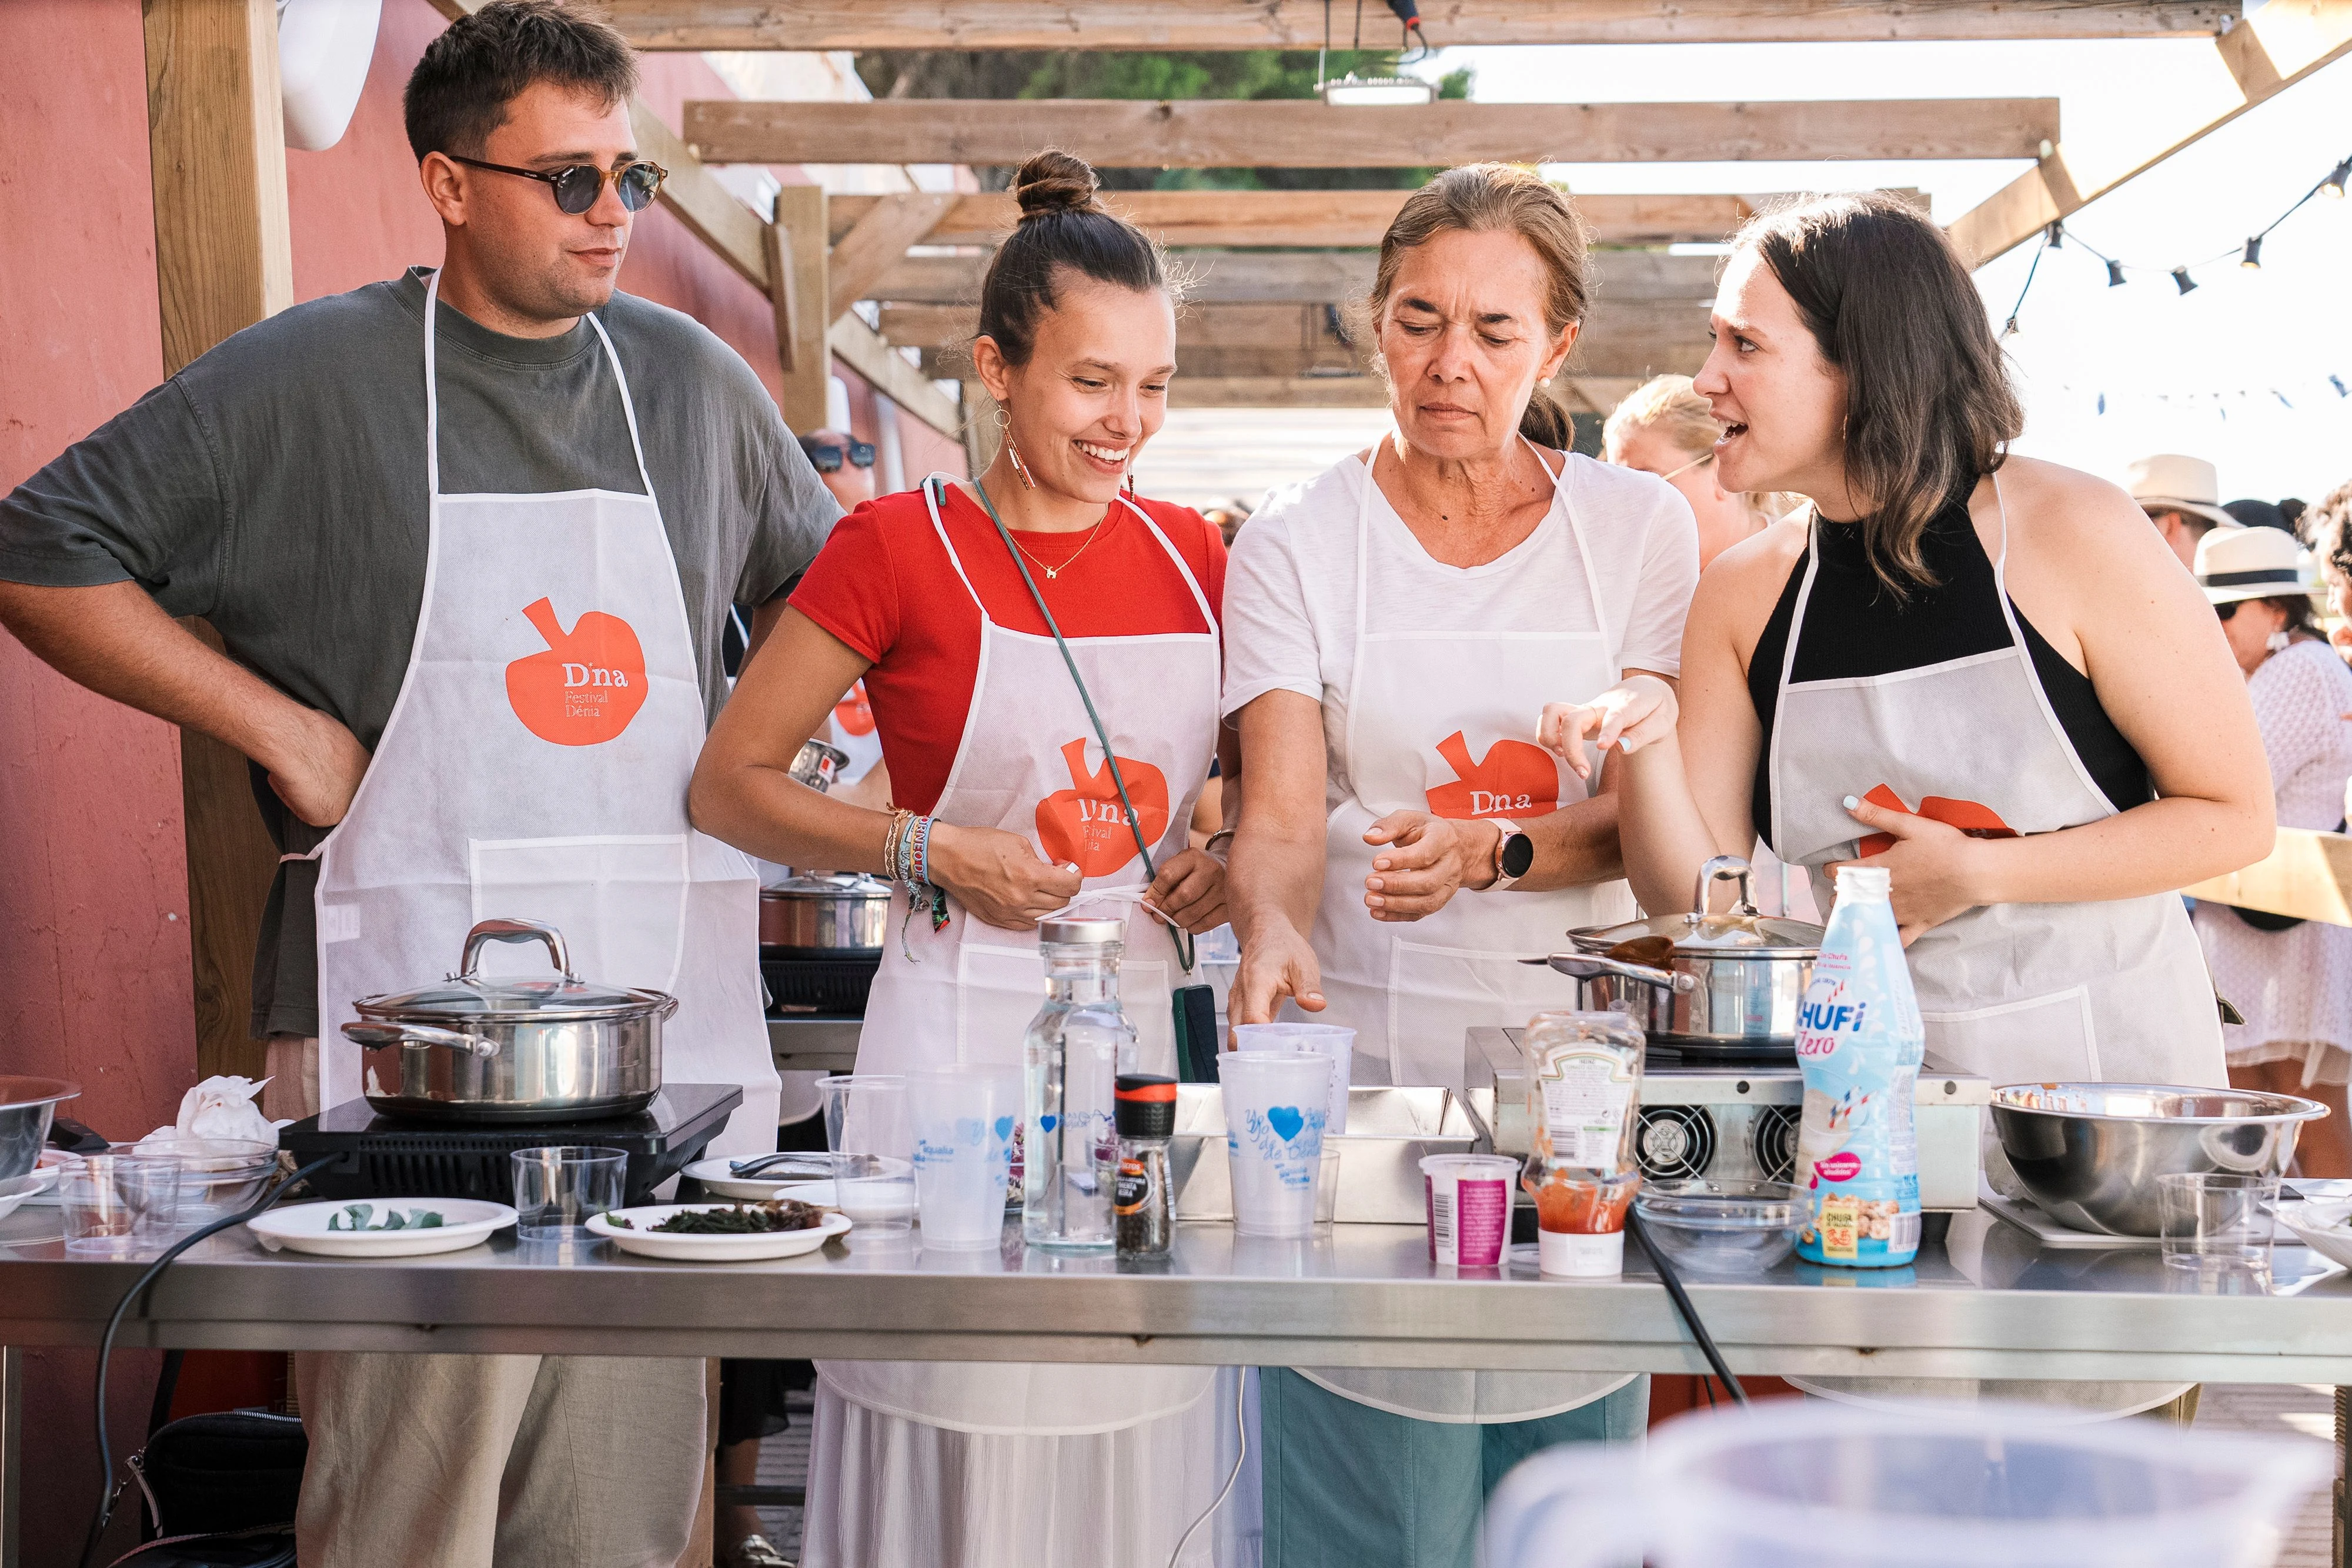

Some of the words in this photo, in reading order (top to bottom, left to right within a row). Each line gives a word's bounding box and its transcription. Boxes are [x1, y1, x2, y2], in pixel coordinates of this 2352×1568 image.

[565, 691, 608, 704] Festival
[566, 705, 600, 717] Dénia
[1470, 791, 1532, 815] Dna
[913, 815, 931, 861] ORNEO
[1798, 1031, 1834, 1055] Zero
